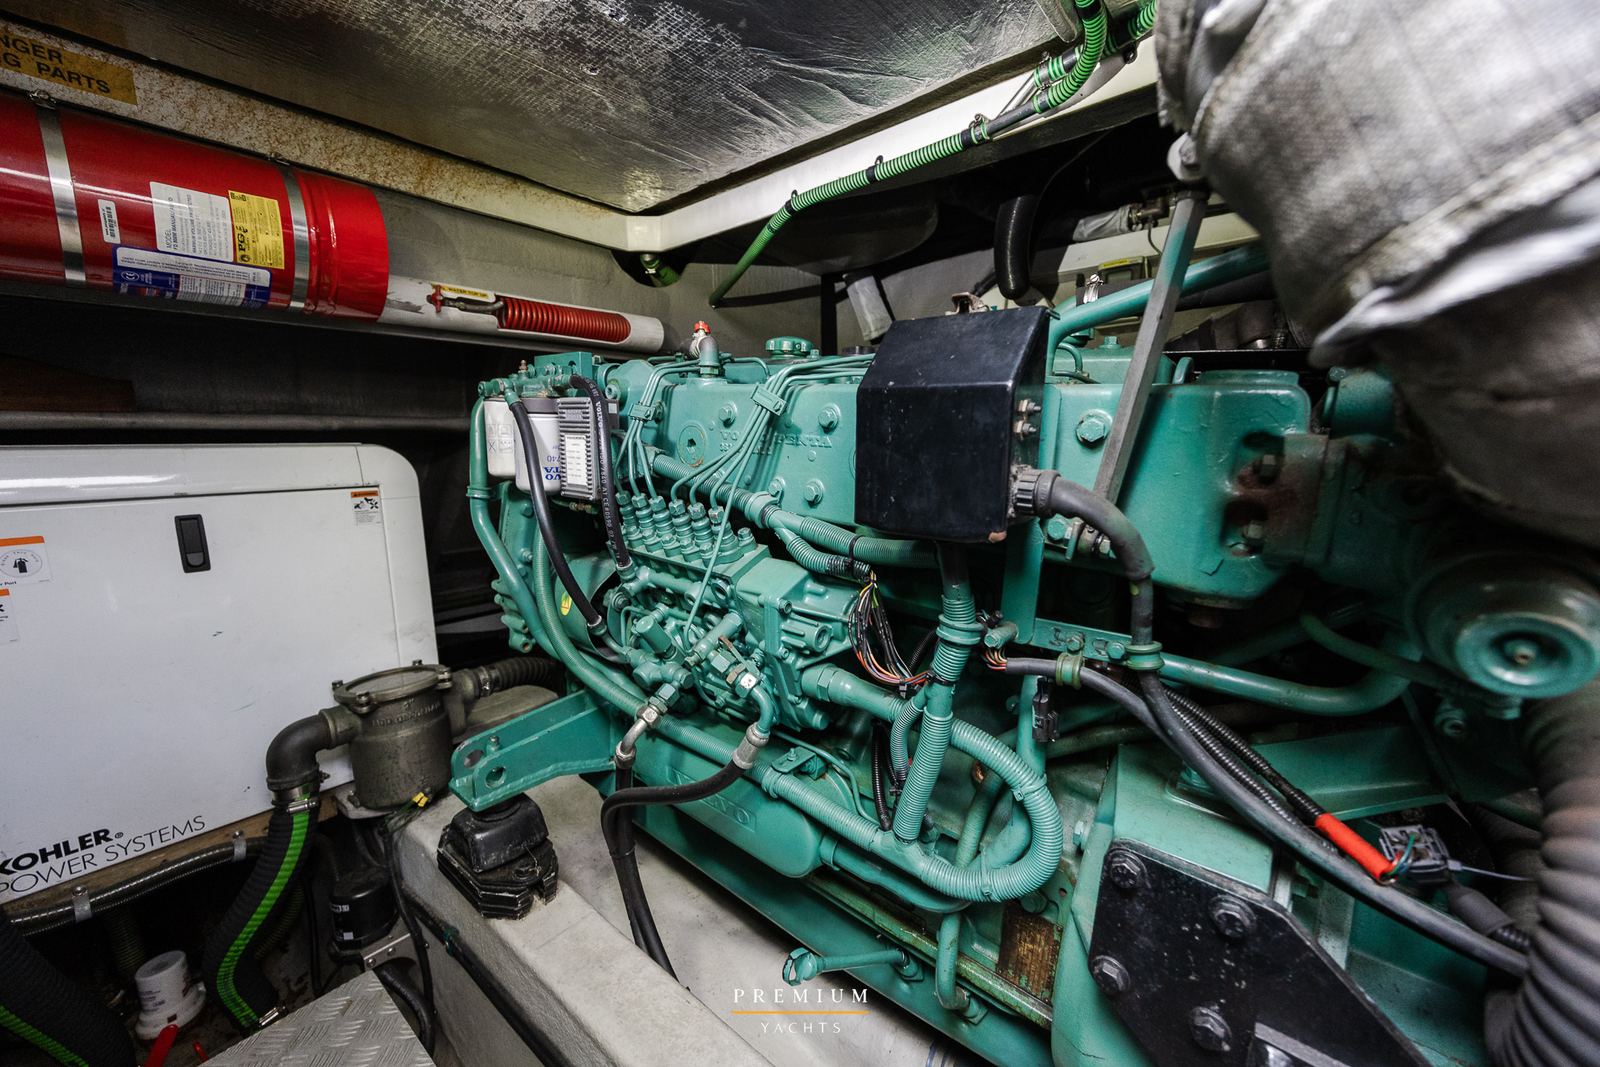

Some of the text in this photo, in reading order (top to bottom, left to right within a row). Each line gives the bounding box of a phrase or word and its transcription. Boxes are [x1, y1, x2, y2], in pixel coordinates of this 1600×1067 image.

[36, 61, 111, 94] PARTS
[0, 828, 114, 876] KOHLER
[0, 815, 206, 894] POWER SYSTEMS
